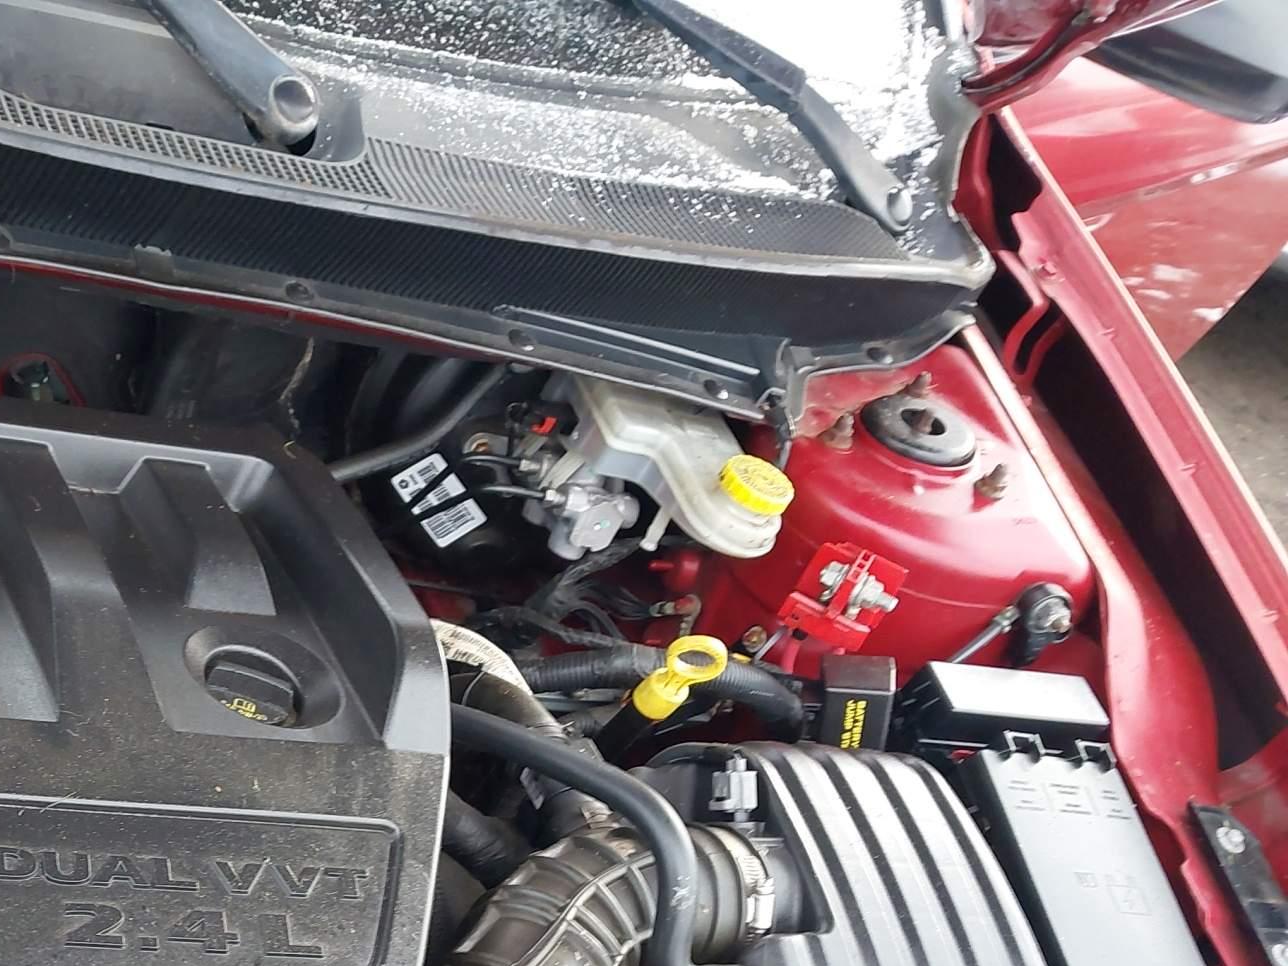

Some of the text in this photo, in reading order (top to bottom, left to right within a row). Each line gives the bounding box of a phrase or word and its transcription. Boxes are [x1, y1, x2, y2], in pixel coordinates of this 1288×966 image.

[850, 700, 867, 749] BATTERY
[214, 858, 370, 901] VVT
[64, 902, 325, 959] 2.4 L
